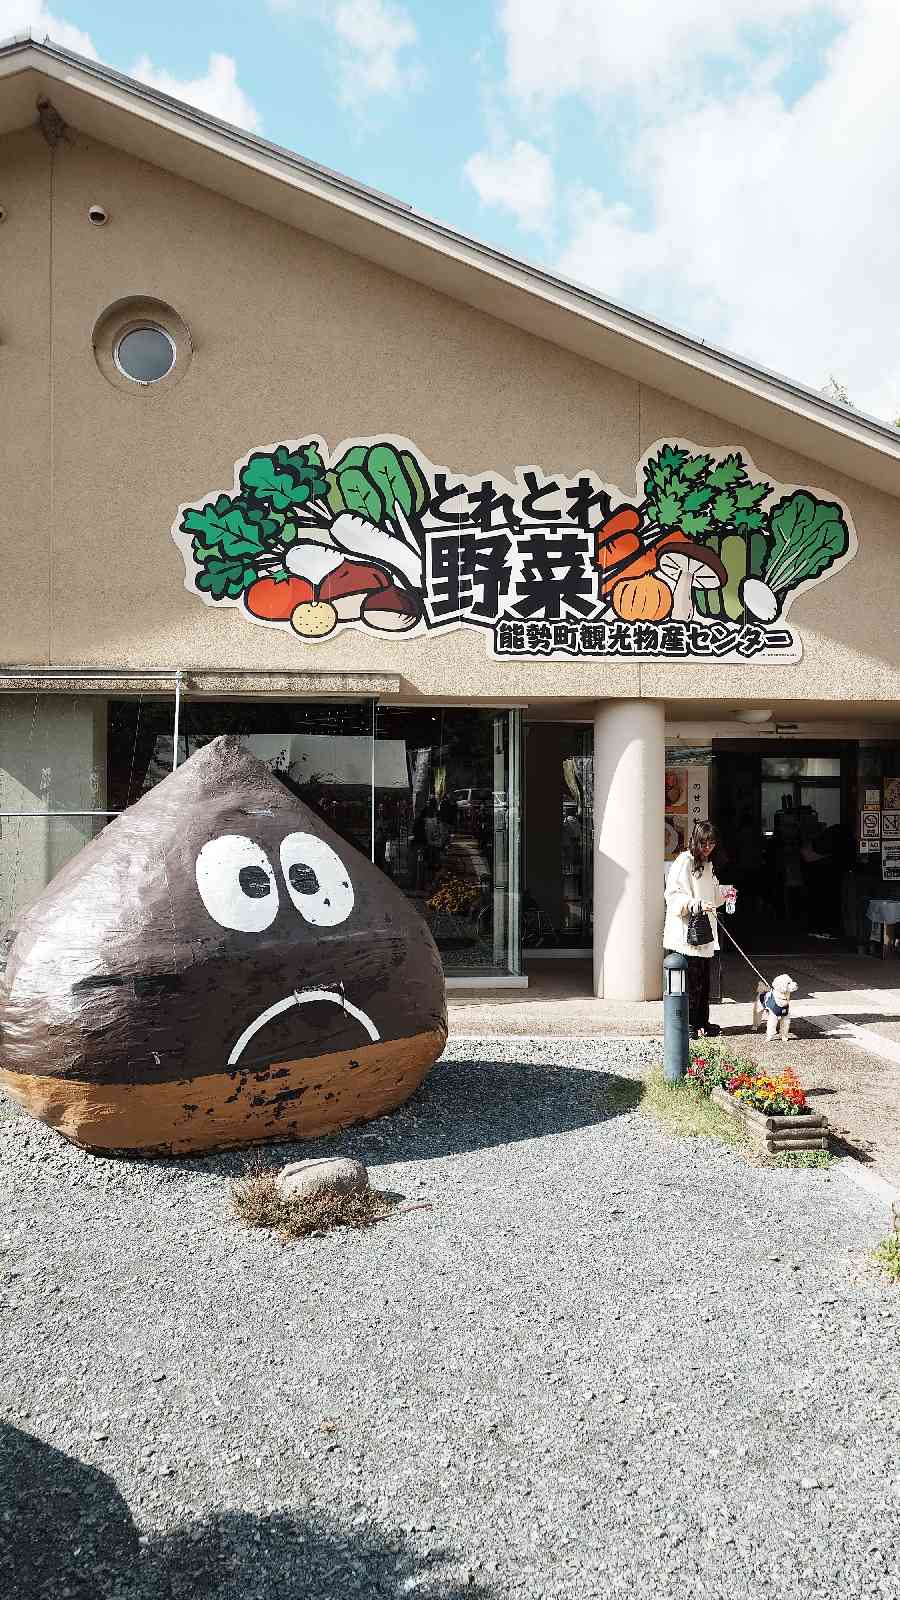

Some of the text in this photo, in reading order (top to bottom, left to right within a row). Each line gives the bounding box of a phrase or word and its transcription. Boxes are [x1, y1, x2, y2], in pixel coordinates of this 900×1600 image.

[430, 472, 612, 532] とれとれ
[431, 533, 598, 618] 野菜
[499, 623, 790, 654] 能勢町観光物産センター
